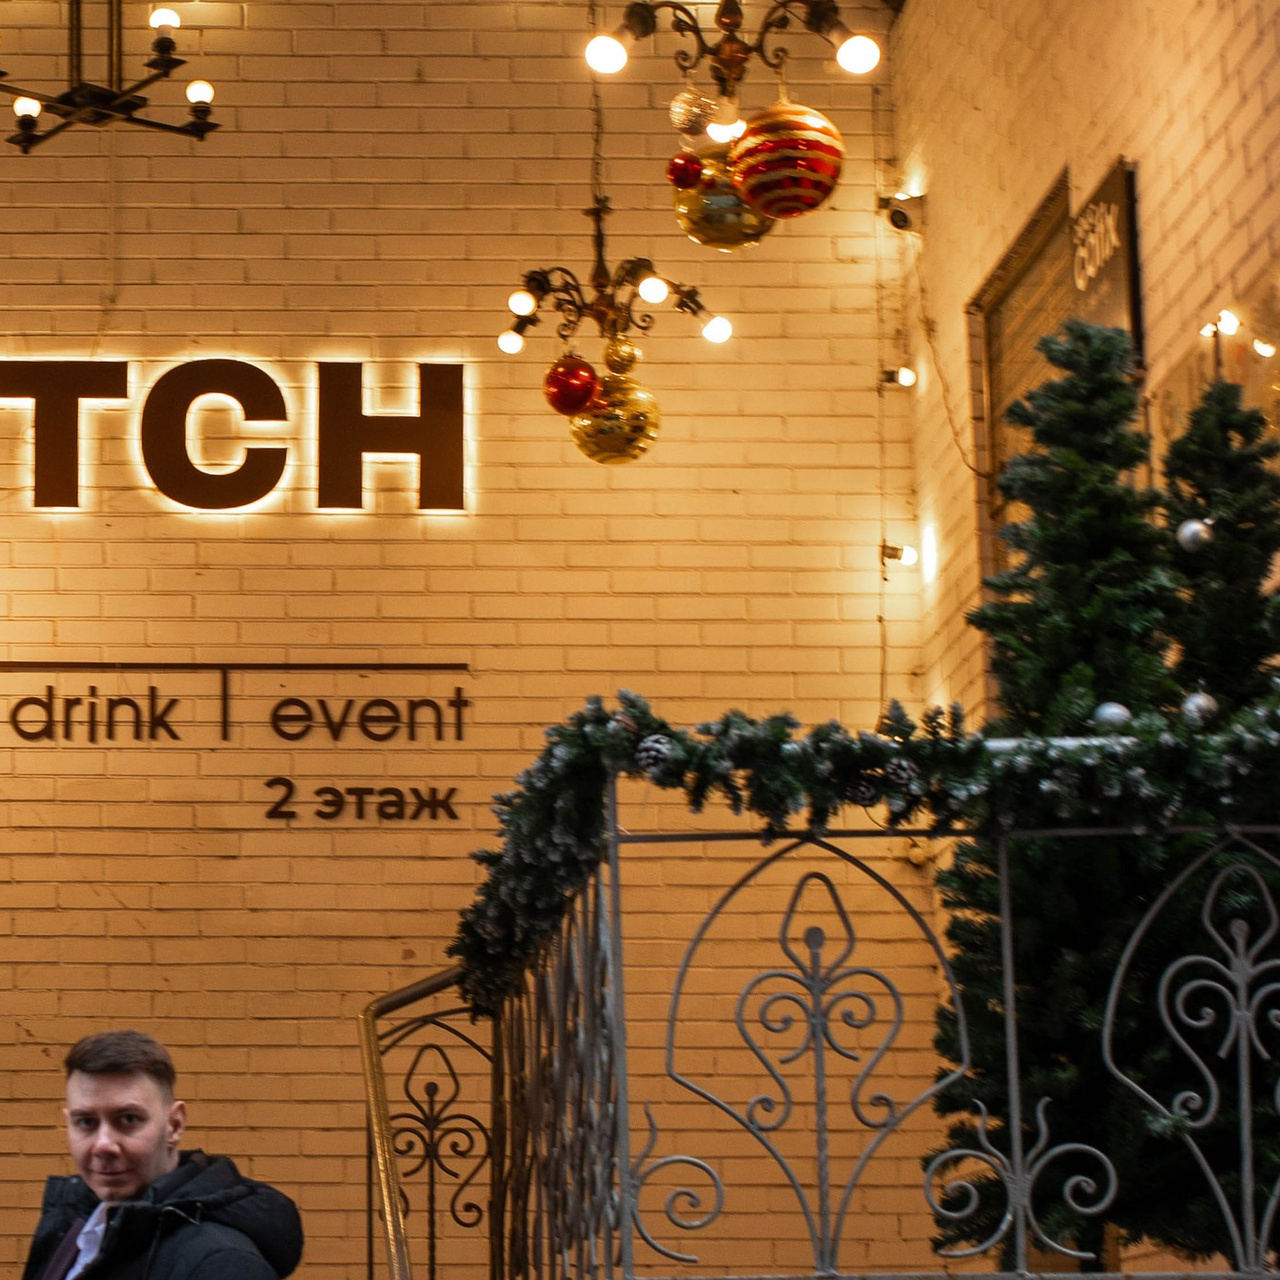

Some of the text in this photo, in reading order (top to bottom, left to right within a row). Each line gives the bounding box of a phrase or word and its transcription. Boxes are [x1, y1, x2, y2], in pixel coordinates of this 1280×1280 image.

[10, 684, 181, 743] drink
[270, 686, 472, 742] event
[264, 776, 459, 821] 2 этаж
